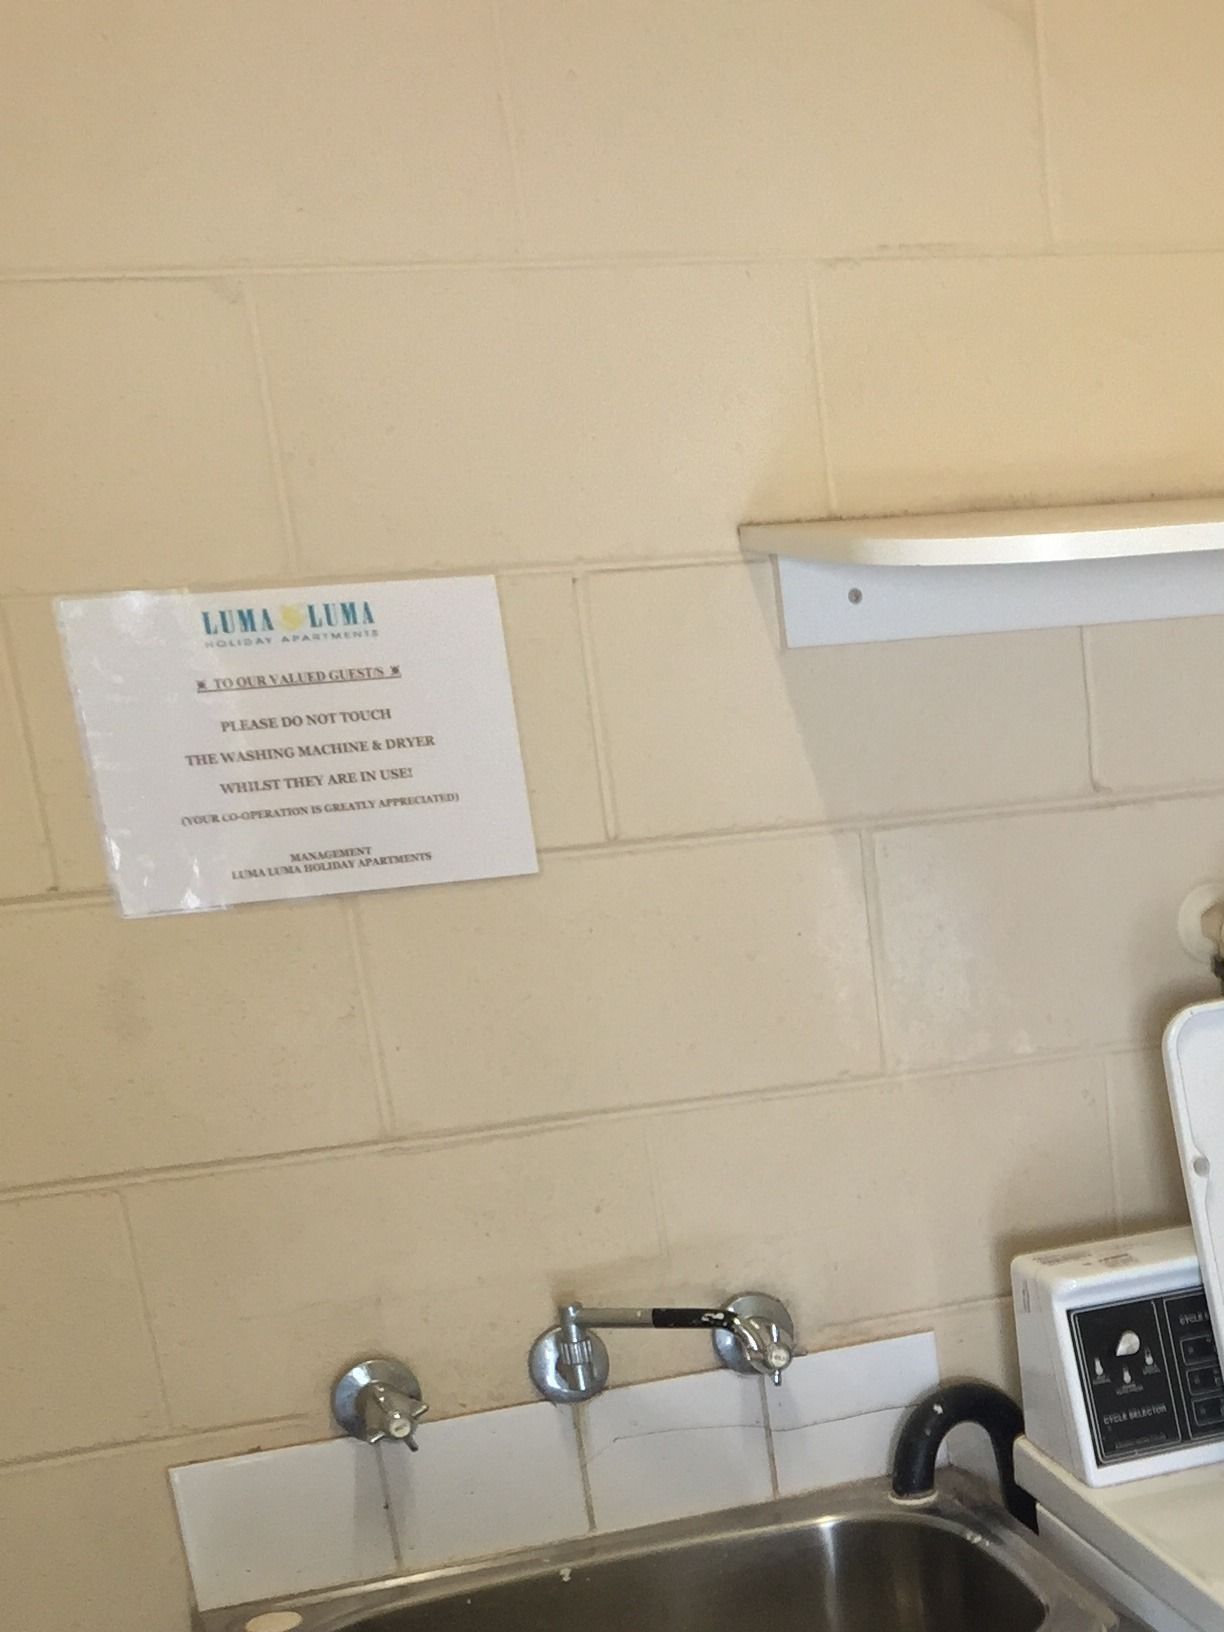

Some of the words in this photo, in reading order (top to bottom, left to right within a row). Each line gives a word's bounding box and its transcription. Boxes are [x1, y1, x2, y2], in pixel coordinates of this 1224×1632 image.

[202, 608, 274, 635] LUMA
[307, 601, 375, 628] LUMA
[205, 637, 273, 648] HOLIDAY
[281, 629, 379, 643] APARTMENTS
[214, 678, 234, 690] TO
[236, 675, 271, 687] OUR
[269, 670, 327, 685] VALUED
[221, 717, 278, 732] PLEASE
[281, 715, 303, 728] DO
[306, 713, 337, 725] NOT
[339, 708, 392, 723] TOUCH
[185, 753, 219, 766] THE
[220, 746, 295, 764] WASHING
[298, 741, 370, 757] MACHINE
[372, 740, 382, 751] &
[385, 735, 435, 750] DRYER
[220, 779, 280, 794] WHILST
[283, 775, 325, 790] THEY
[327, 773, 358, 786] ARE
[360, 770, 378, 782] IN
[380, 767, 413, 780] USE!
[181, 813, 221, 827] (YOUR
[222, 805, 309, 823] CO-OPERATION
[311, 804, 323, 815] IS
[324, 799, 377, 813] GREATLY
[231, 868, 267, 880] LUMA
[268, 865, 302, 877] LUMA
[304, 860, 358, 874] HOLIDAY
[358, 851, 432, 868] APARTMENTS
[290, 846, 372, 862] MANAGEMENT
